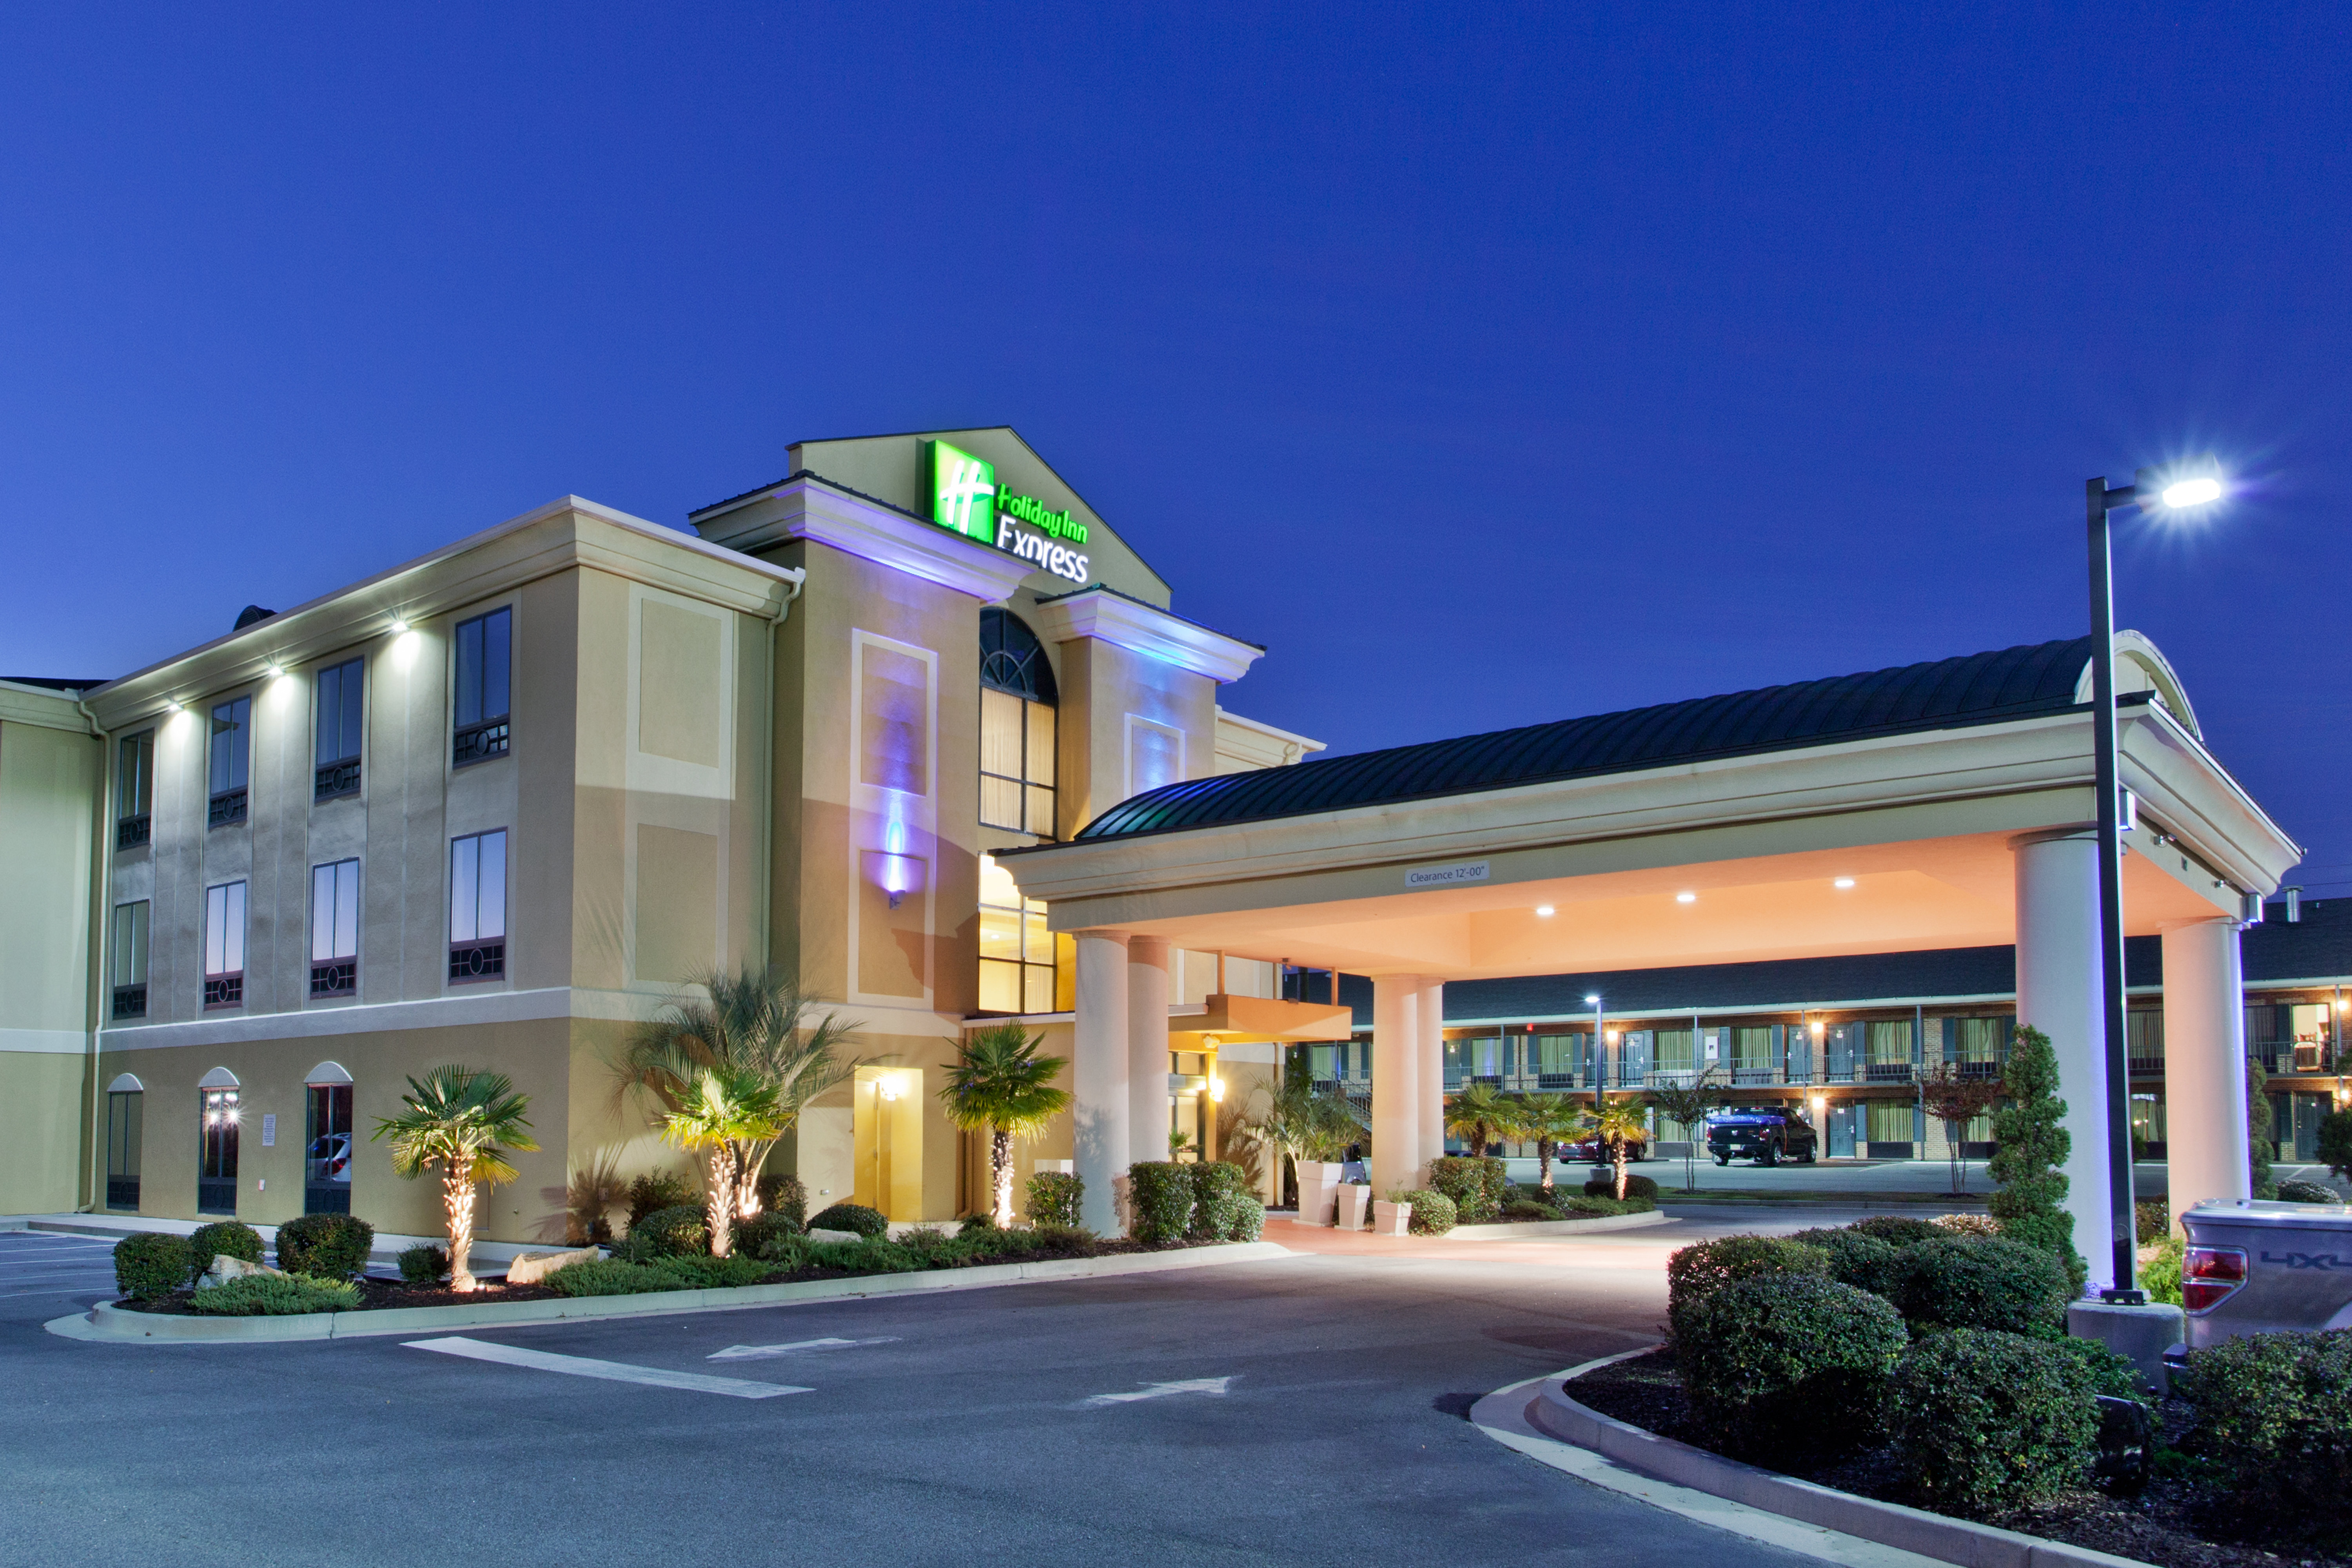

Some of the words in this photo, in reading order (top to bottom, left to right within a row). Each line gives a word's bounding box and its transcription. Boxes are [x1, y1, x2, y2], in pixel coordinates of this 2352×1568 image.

[998, 483, 1062, 538] Holiday
[1062, 510, 1088, 544] Inn
[1411, 871, 1453, 882] Clearance
[1455, 866, 1485, 877] 12'-00"
